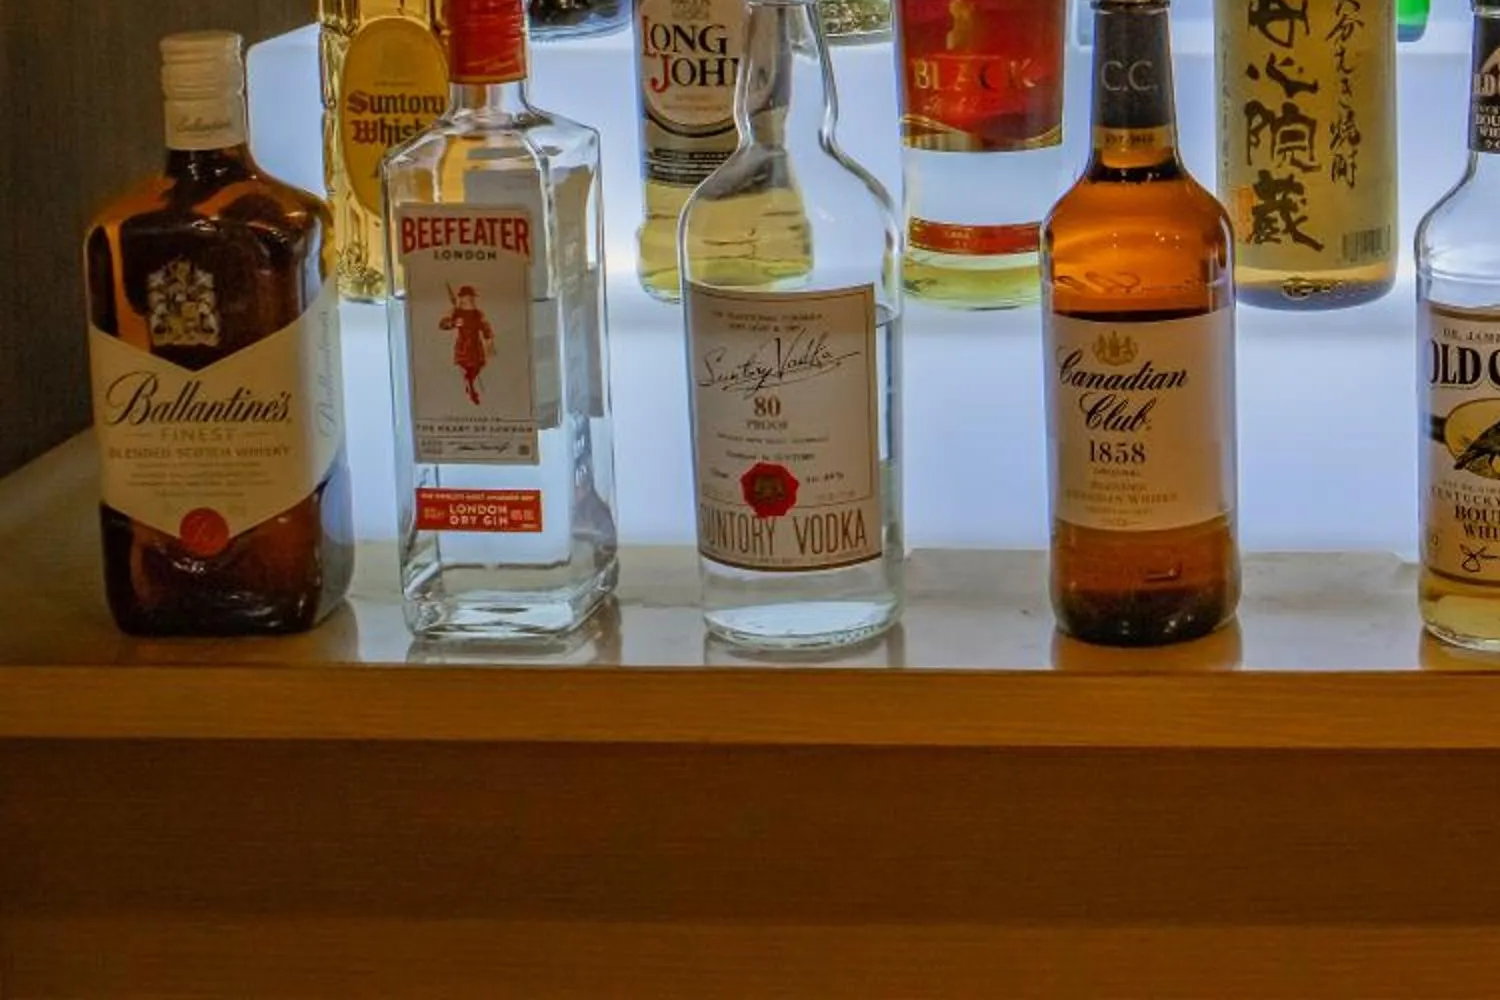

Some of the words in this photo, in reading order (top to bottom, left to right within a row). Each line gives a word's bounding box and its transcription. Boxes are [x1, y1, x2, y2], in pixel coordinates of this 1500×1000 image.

[347, 89, 446, 116] Suntory
[351, 117, 427, 147] Whis
[401, 216, 531, 257] BEEFEATER
[434, 250, 497, 260] LONDON
[1056, 346, 1188, 391] Canadian
[106, 370, 293, 426] Ballantine's
[753, 396, 781, 417] 80
[1090, 440, 1146, 464] 1858
[449, 503, 508, 515] LONDON
[792, 508, 868, 555] VODKA
